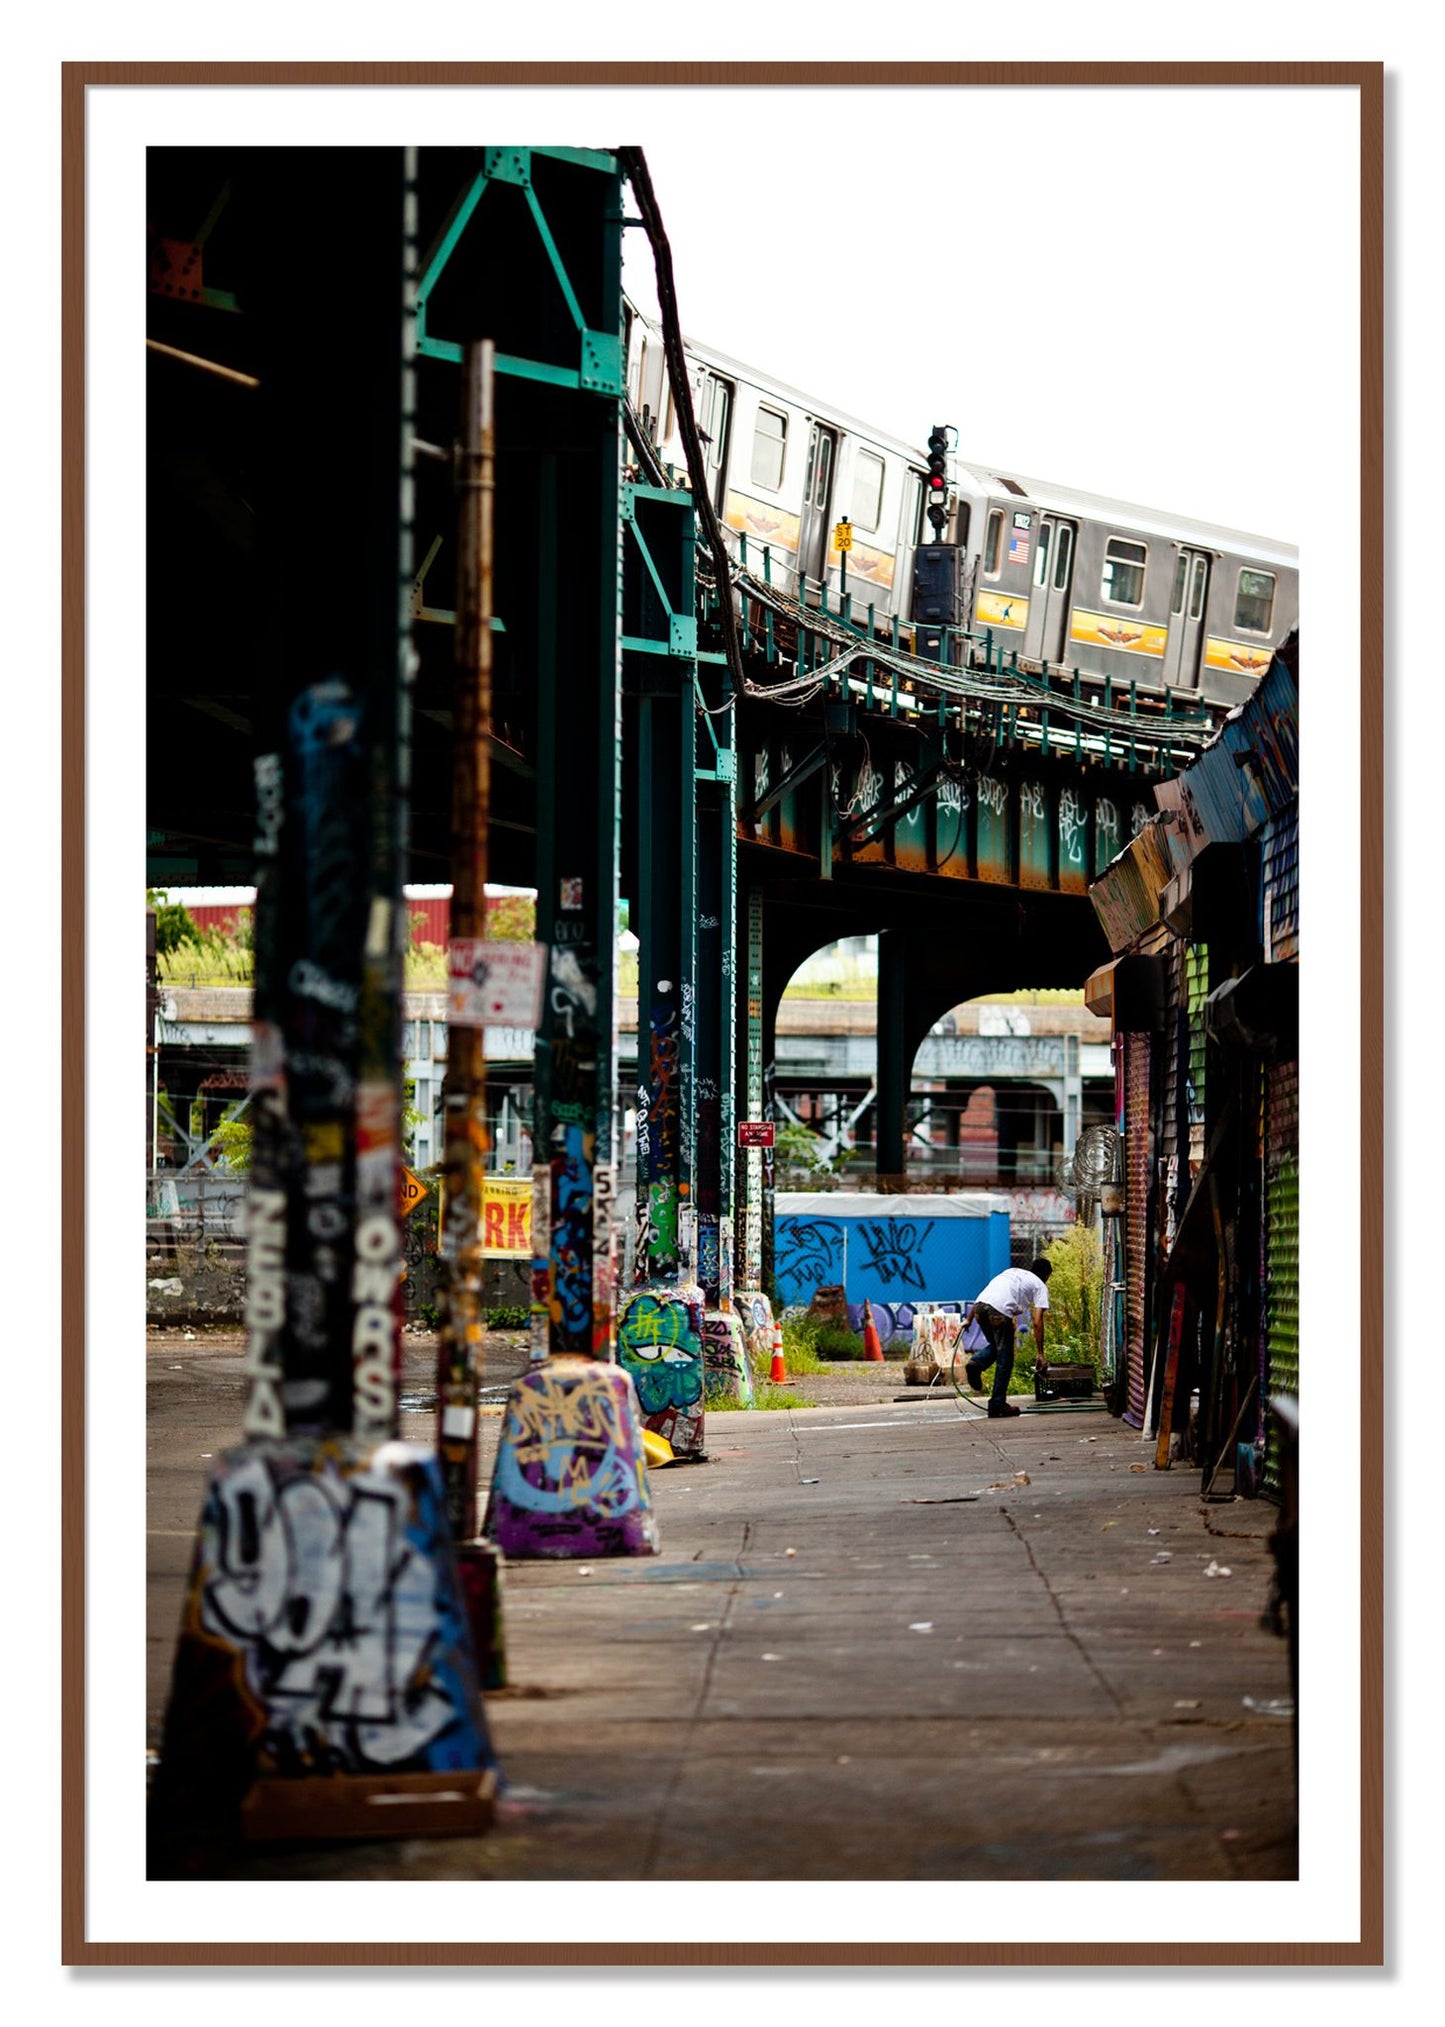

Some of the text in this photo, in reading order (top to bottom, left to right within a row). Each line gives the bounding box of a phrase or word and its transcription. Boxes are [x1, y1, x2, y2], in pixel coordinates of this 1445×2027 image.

[837, 537, 851, 548] 20
[399, 1184, 419, 1199] ND
[484, 1201, 530, 1249] RK
